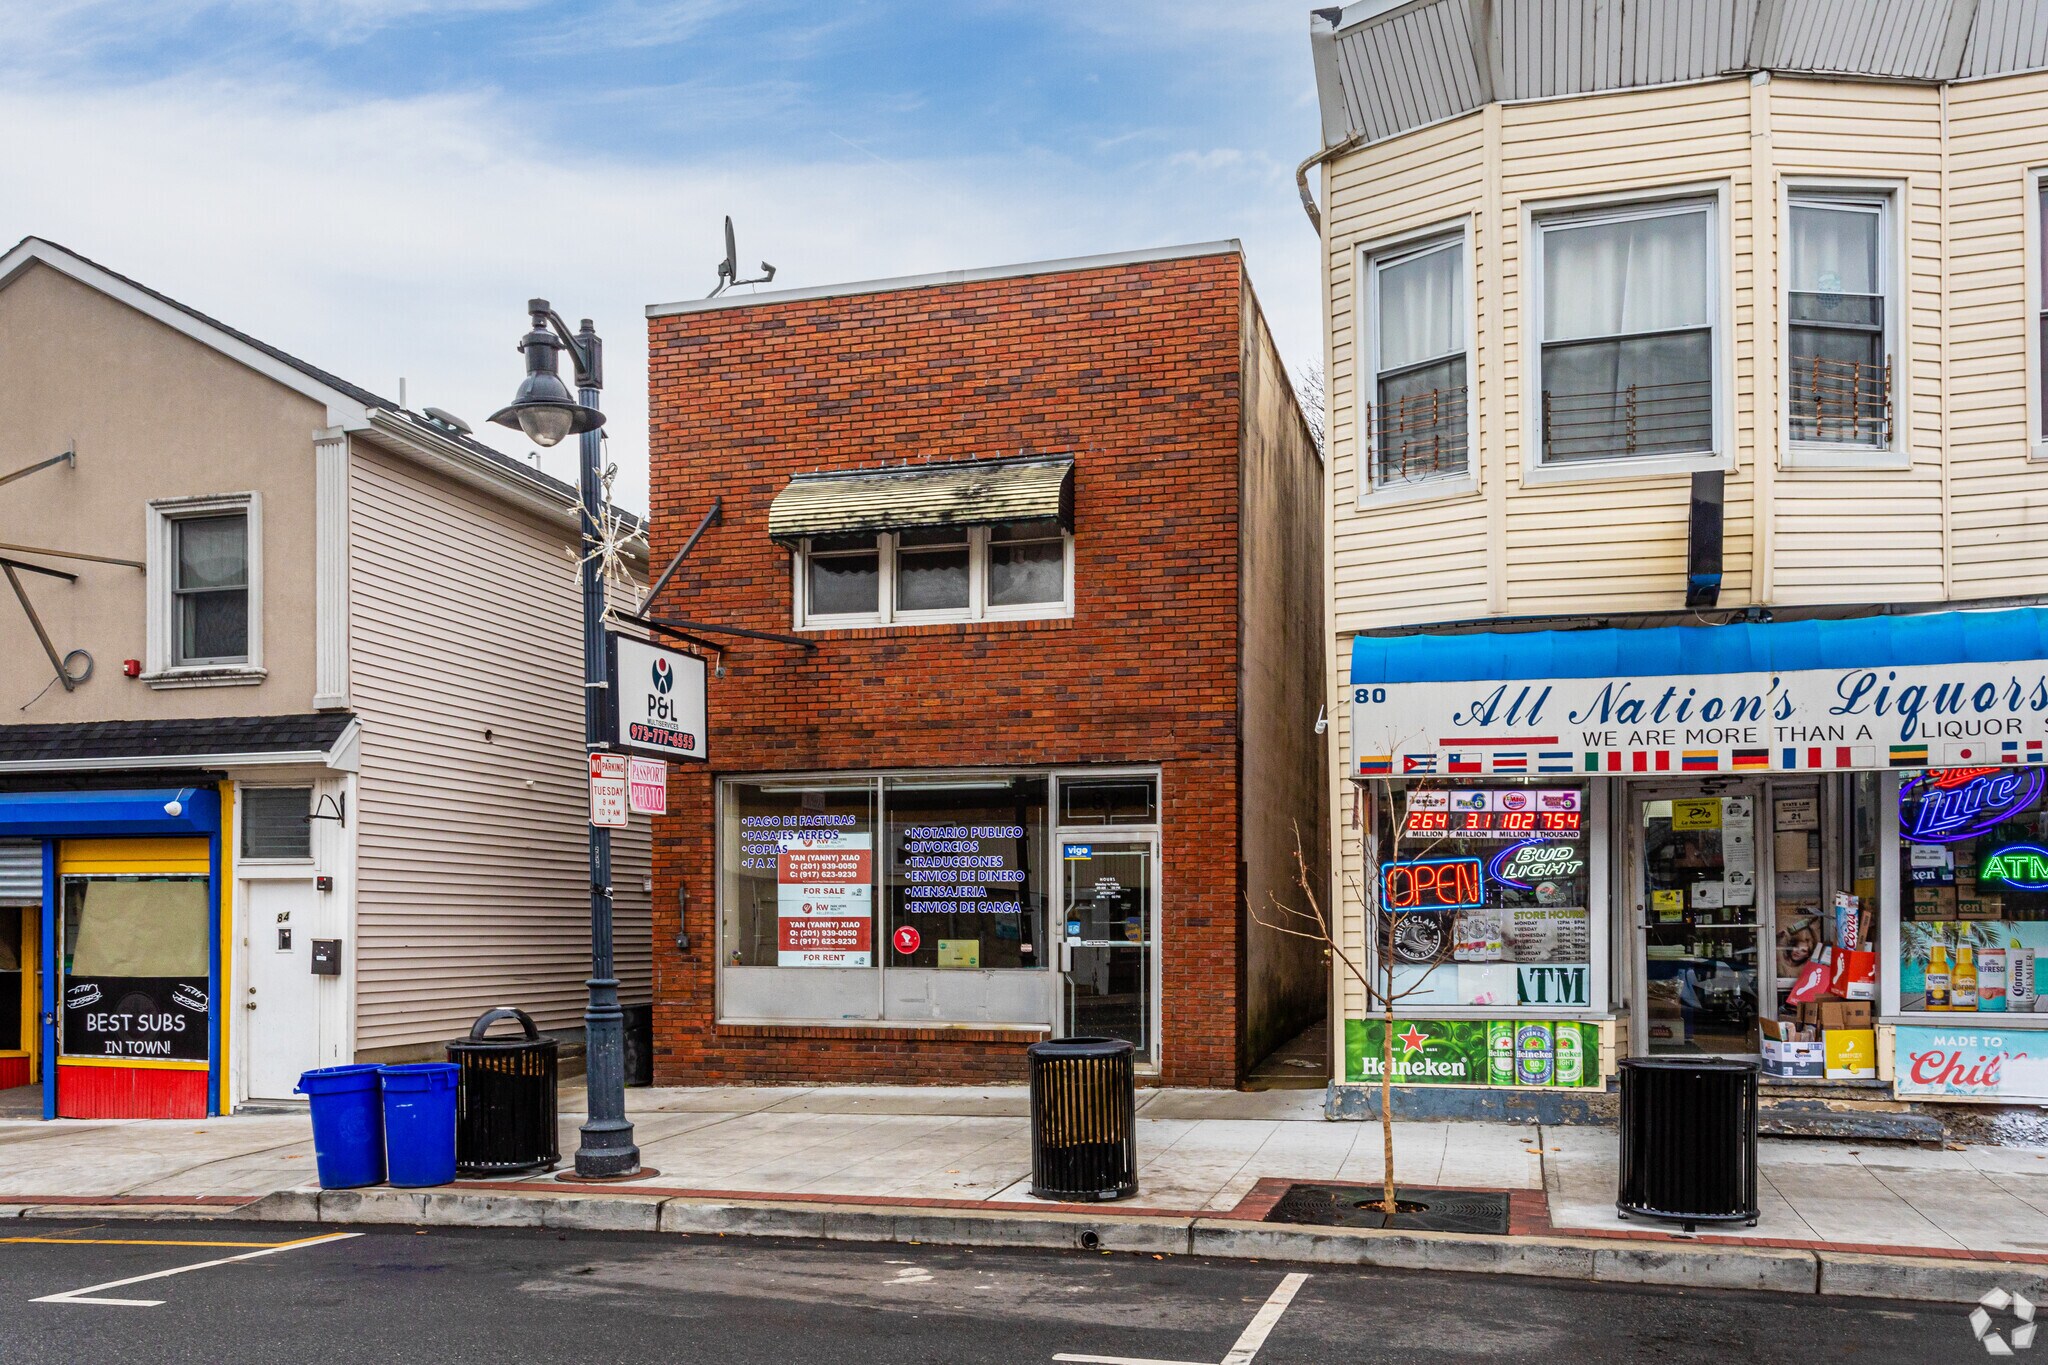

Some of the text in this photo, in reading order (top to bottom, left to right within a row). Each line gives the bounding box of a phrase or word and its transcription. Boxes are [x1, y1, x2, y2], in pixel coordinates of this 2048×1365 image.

[1355, 688, 1386, 703] 80
[647, 693, 677, 722] P&L
[1453, 669, 2048, 742] All Nation's Liquors
[631, 723, 694, 750] 973-777-6555
[1583, 717, 2023, 746] WE ARE MORE THAN A LIQUOR
[591, 759, 624, 773] NO PARKING
[632, 764, 664, 782] PASSPORT
[594, 785, 624, 797] TUESDAY
[632, 785, 664, 809] PHOTO
[1563, 792, 1576, 810] 5
[598, 808, 606, 816] TO
[1792, 812, 1801, 820] 21
[748, 814, 856, 827] PAGO DE FACTURAS
[1410, 814, 1447, 828] 264
[1503, 814, 1534, 828] 102
[1542, 814, 1578, 828] 754
[748, 829, 840, 841] PASAJES AEREOS
[911, 826, 1024, 839] NOTARIO PUBLICO
[748, 844, 789, 854] COPIAS
[911, 841, 980, 852] DIVORCIOS
[1068, 846, 1088, 856] vigo
[808, 854, 839, 862] (YANNY)
[1516, 846, 1574, 863] BUD
[911, 856, 1004, 868] TRADUCCIONES
[911, 870, 1026, 882] ENVIOS DE DINERO
[1502, 860, 1584, 879] LIGHT
[1386, 862, 1479, 906] OPEN
[911, 886, 988, 898] MENSAJERIA
[816, 902, 829, 911] kw
[911, 901, 1022, 914] ENVIOS DE CARGA
[276, 911, 290, 923] 84
[1514, 910, 1586, 920] STORE HOURS
[808, 921, 839, 929] (YANNY)
[1394, 916, 1438, 945] WHITE CLAW
[1844, 913, 1857, 950] Coors
[1402, 948, 1420, 958] HARD
[2012, 960, 2025, 997] Corona
[86, 1012, 186, 1032] BEST SUBS
[104, 1040, 170, 1054] IN TOWN!
[1934, 1036, 2003, 1048] MADE TO
[1516, 1050, 1552, 1058] Heineken
[1362, 1057, 1466, 1076] Heineken
